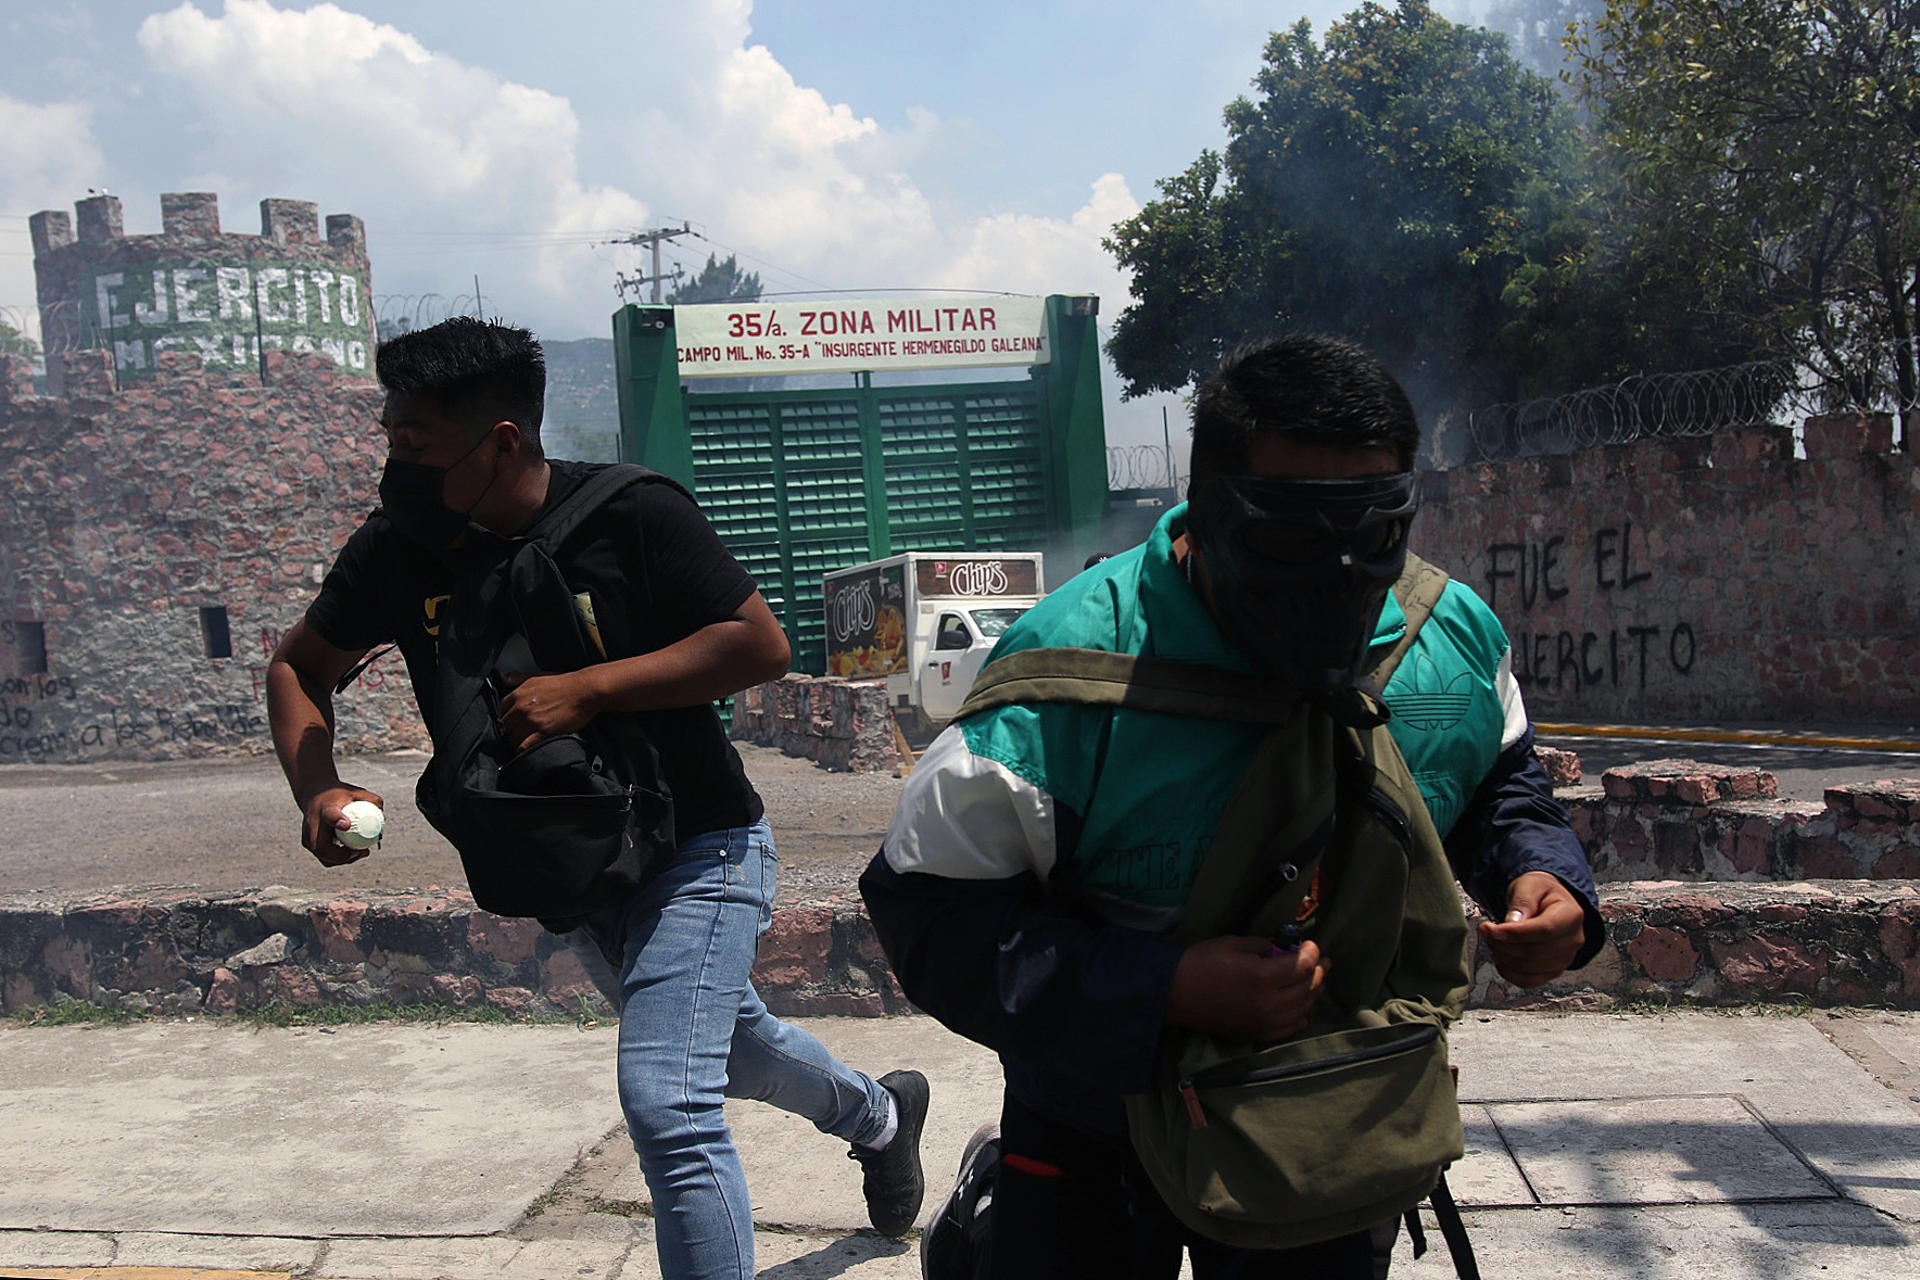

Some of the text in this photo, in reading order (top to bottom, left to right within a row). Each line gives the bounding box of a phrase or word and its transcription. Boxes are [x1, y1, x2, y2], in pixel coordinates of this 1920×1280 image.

[95, 267, 359, 329] EJERCITO
[799, 310, 875, 336] ZONA
[888, 307, 997, 334] MILITAR
[677, 346, 721, 363] CAMPO
[727, 345, 753, 361] MIL.
[779, 343, 810, 359] 35-A
[902, 339, 987, 356] HERMENEGILDO
[1484, 522, 1653, 610] FUE EL
[1519, 622, 1696, 693] JERCITO
